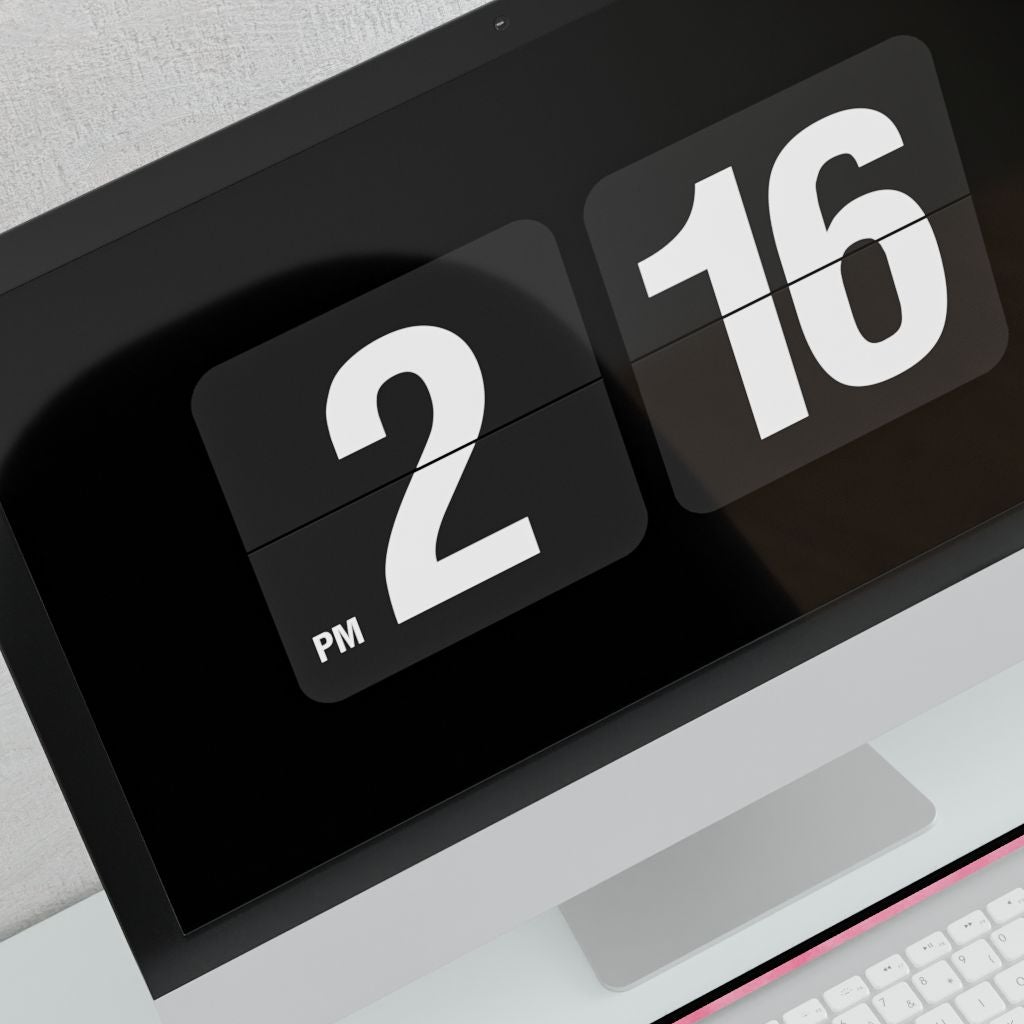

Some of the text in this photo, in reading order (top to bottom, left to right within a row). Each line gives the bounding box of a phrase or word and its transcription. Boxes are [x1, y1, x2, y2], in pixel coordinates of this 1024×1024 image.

[326, 107, 949, 624] 2 16
[312, 616, 365, 663] PM
[878, 997, 887, 1007] 7
[919, 976, 928, 985] 8
[958, 955, 966, 964] 9
[977, 998, 985, 1008] I
